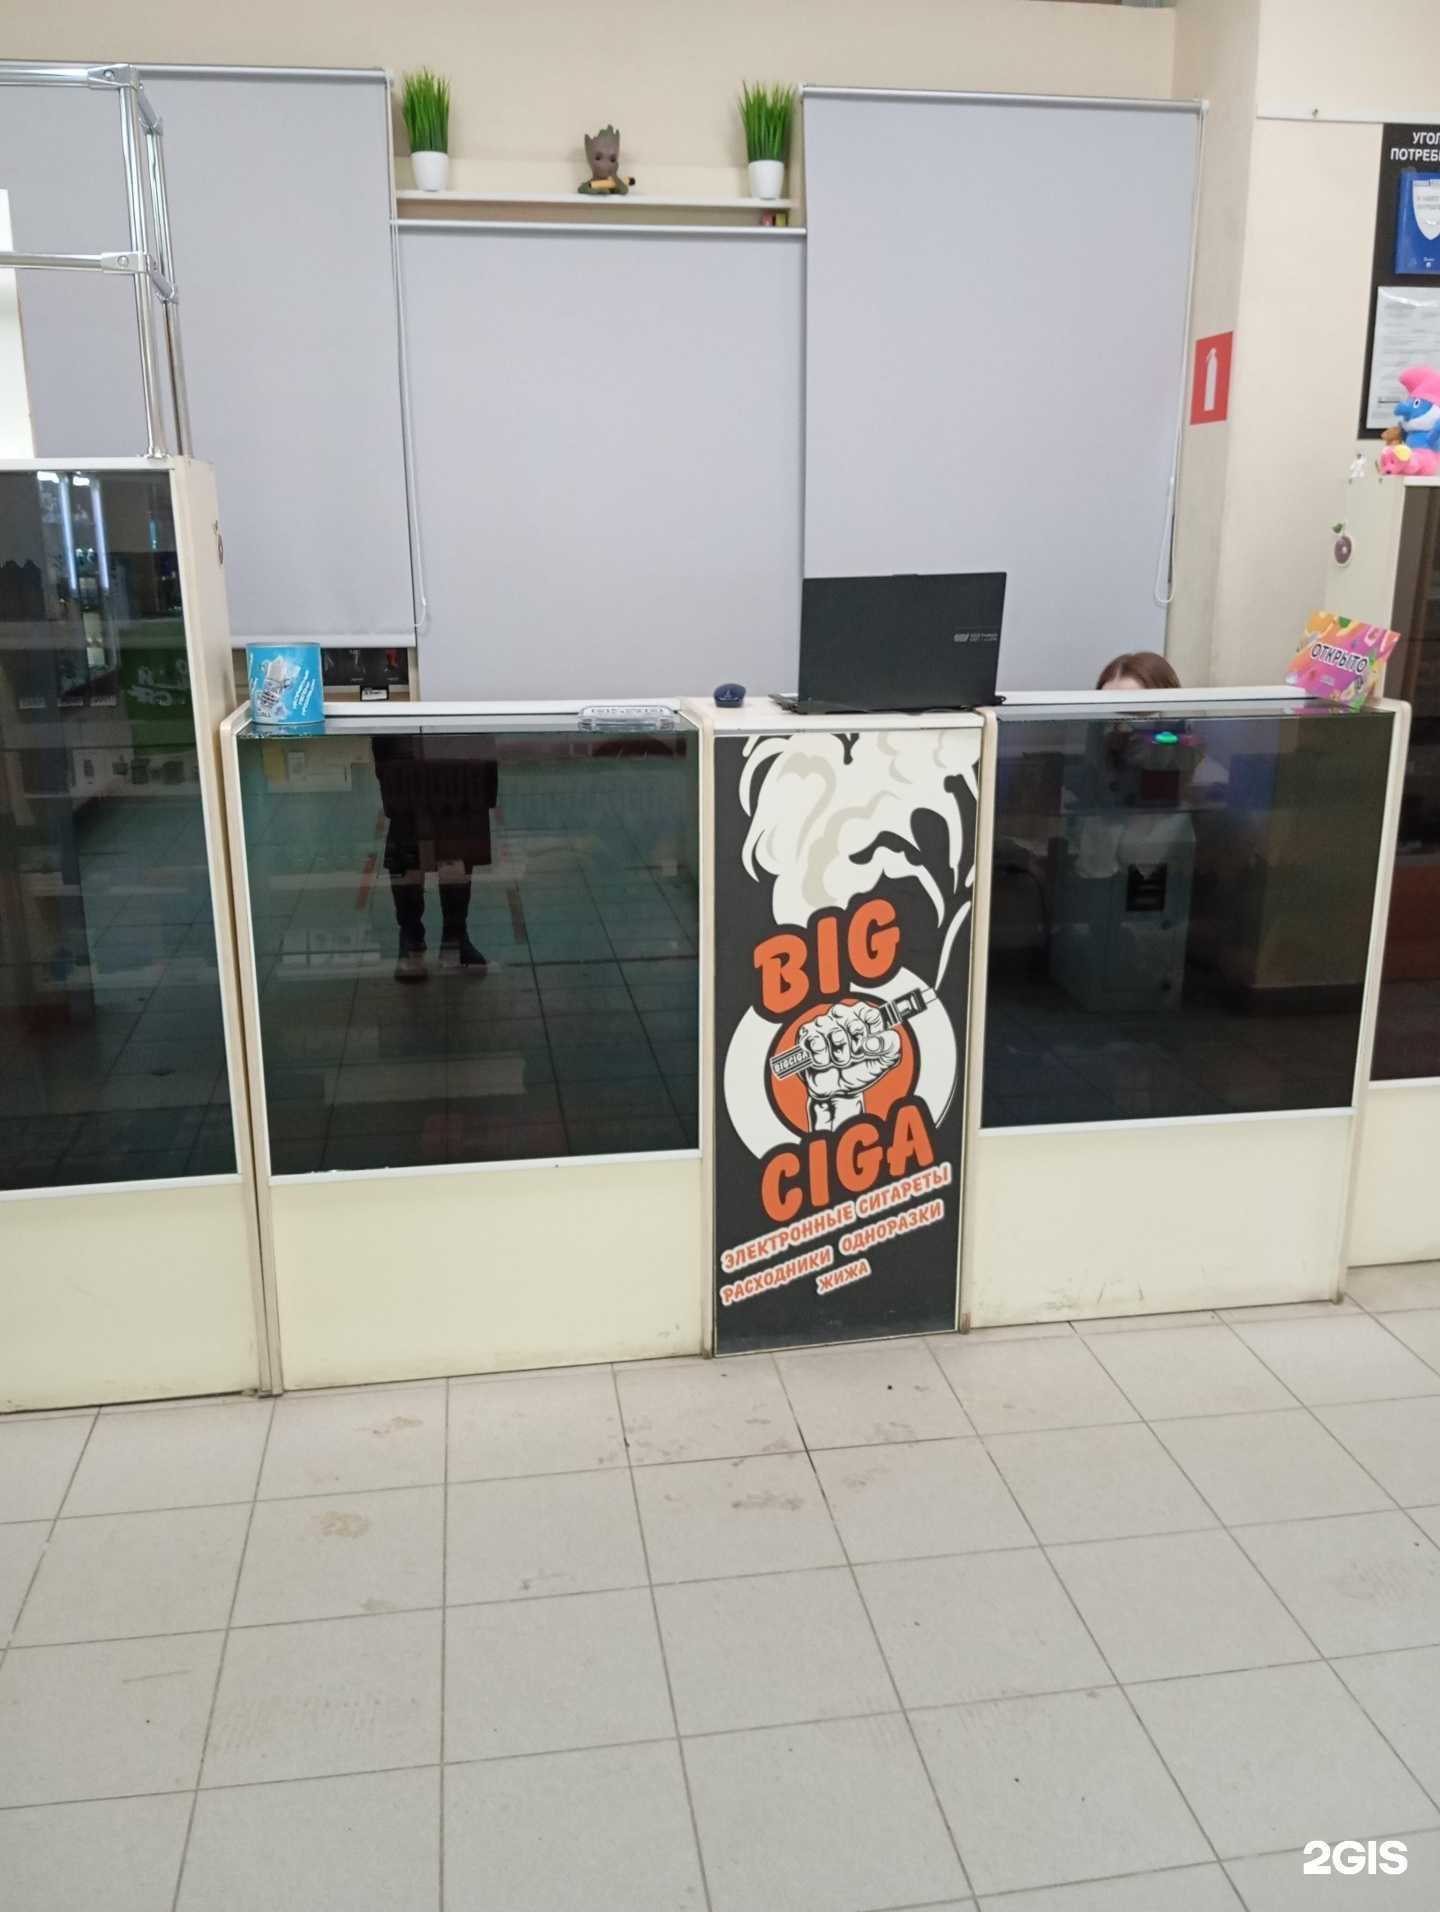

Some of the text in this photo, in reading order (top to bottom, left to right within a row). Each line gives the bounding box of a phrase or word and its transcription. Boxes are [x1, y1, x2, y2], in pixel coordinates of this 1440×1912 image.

[1390, 148, 1440, 162] ПОТРЕБ
[1311, 643, 1368, 673] ОТКРЫТО
[753, 899, 900, 1014] BIG
[761, 1104, 934, 1223] CIGA
[721, 1201, 943, 1304] РАСХОДНИКИ ОДНОРАЗКИ
[723, 1163, 950, 1271] ЭЛЕКТРОННЫЕ СИГАРЕТЫ
[817, 1260, 870, 1292] ЖИЖА
